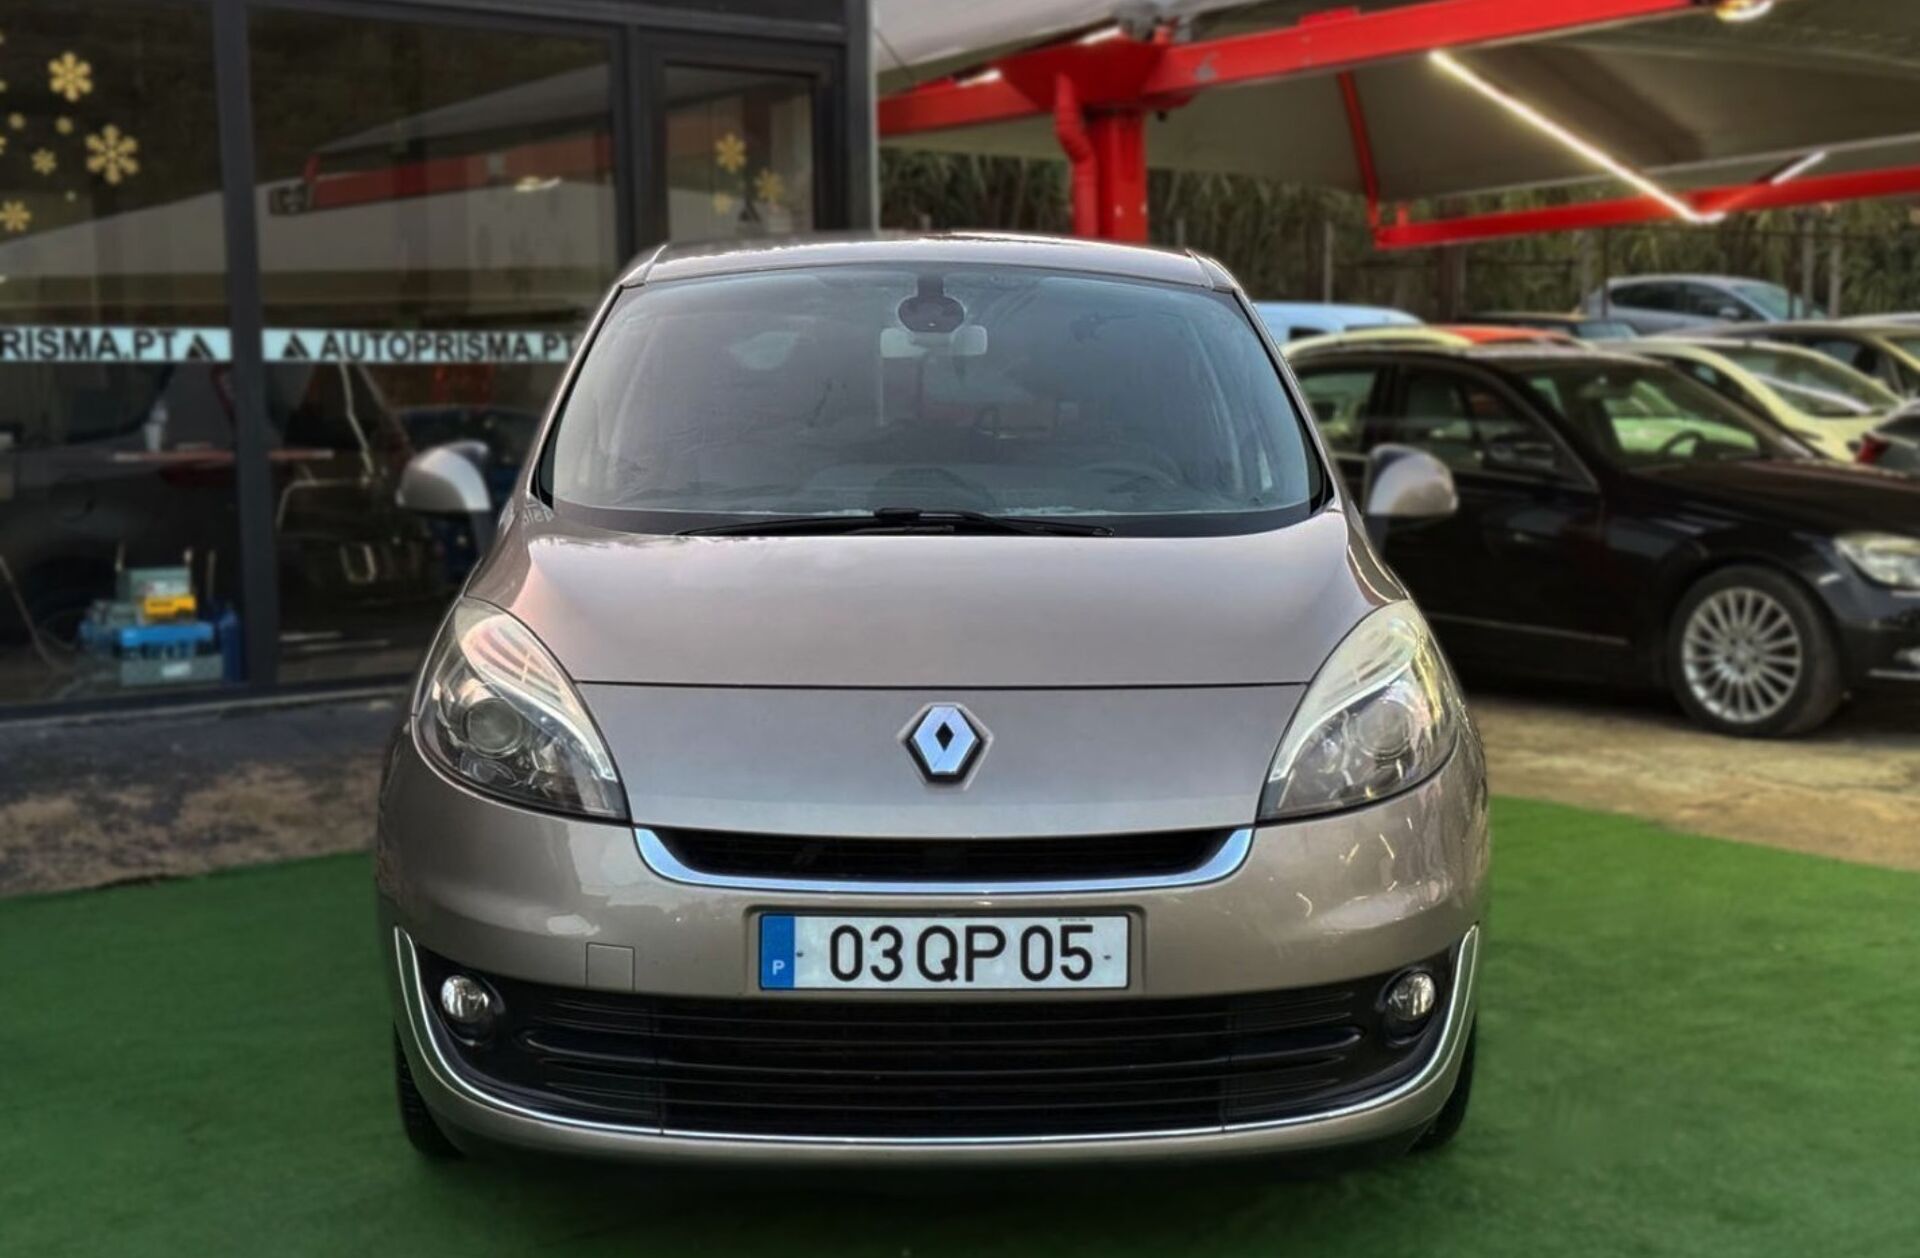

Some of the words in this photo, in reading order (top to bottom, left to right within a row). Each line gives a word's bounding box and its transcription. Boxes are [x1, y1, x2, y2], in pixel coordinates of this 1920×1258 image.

[319, 331, 577, 361] AUTOPRISMA.PT
[772, 959, 785, 976] P
[830, 924, 904, 982] 03
[916, 924, 1007, 983] QP
[1020, 924, 1094, 982] 05
